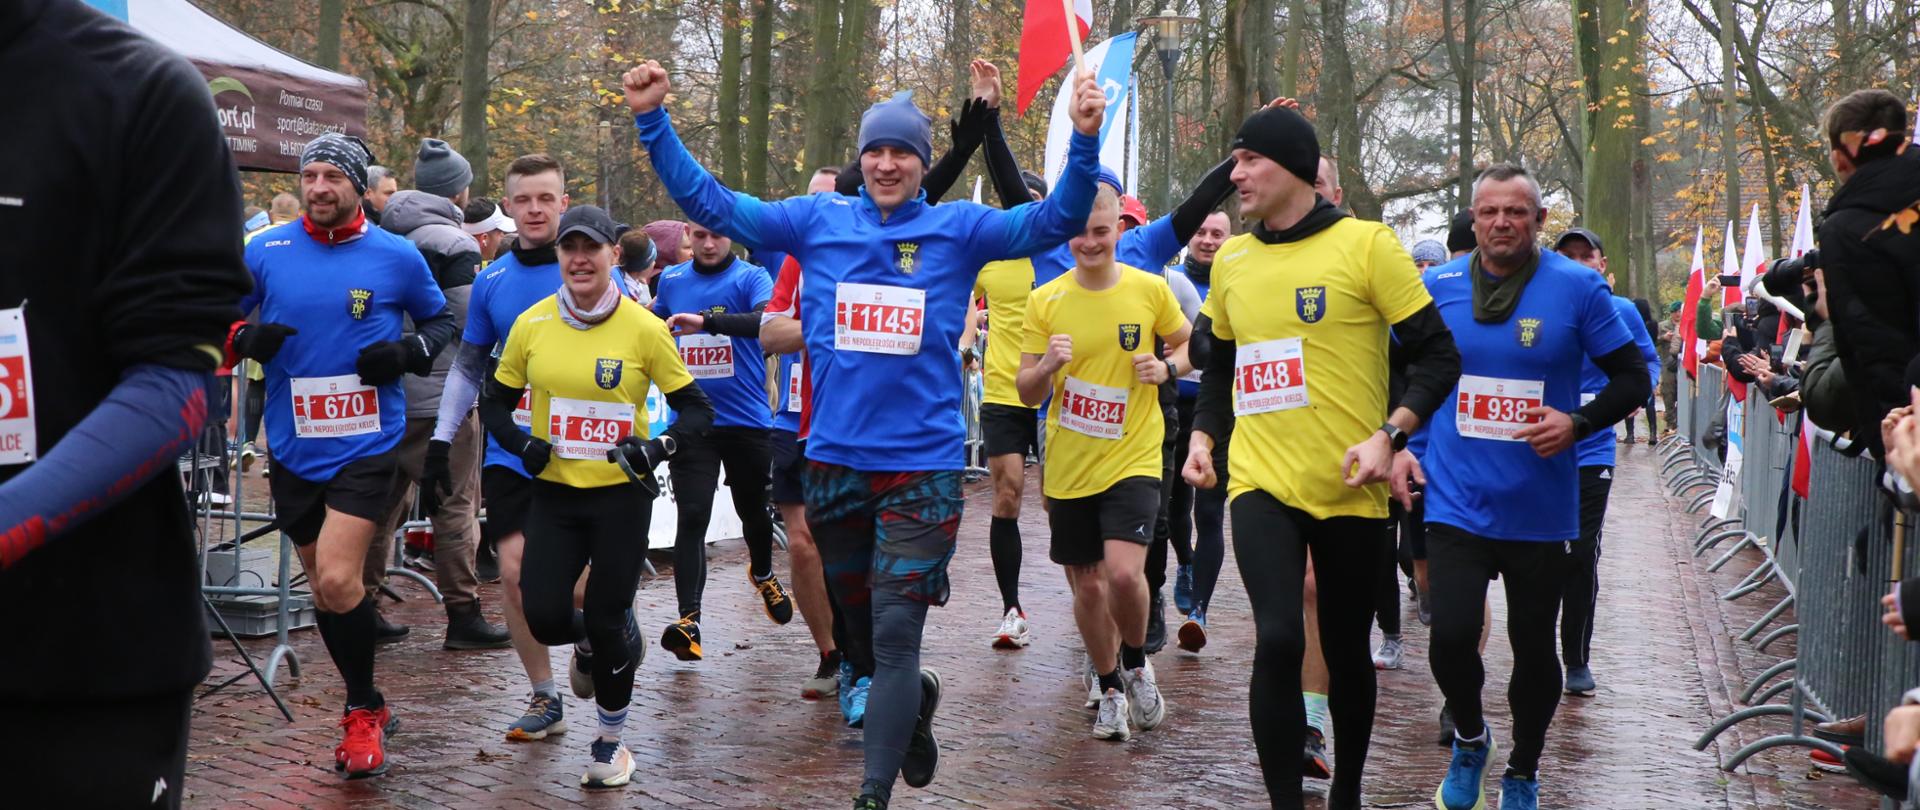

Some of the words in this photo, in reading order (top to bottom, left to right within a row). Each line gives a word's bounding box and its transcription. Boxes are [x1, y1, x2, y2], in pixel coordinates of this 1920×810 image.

[279, 90, 304, 108] Pomiar
[305, 97, 324, 111] czasu
[860, 306, 915, 335] 1145
[692, 347, 728, 366] 1122
[1252, 361, 1290, 392] 648
[324, 393, 365, 419] 670
[1078, 397, 1120, 423] 1384
[1487, 397, 1529, 423] 938
[580, 419, 620, 443] 649
